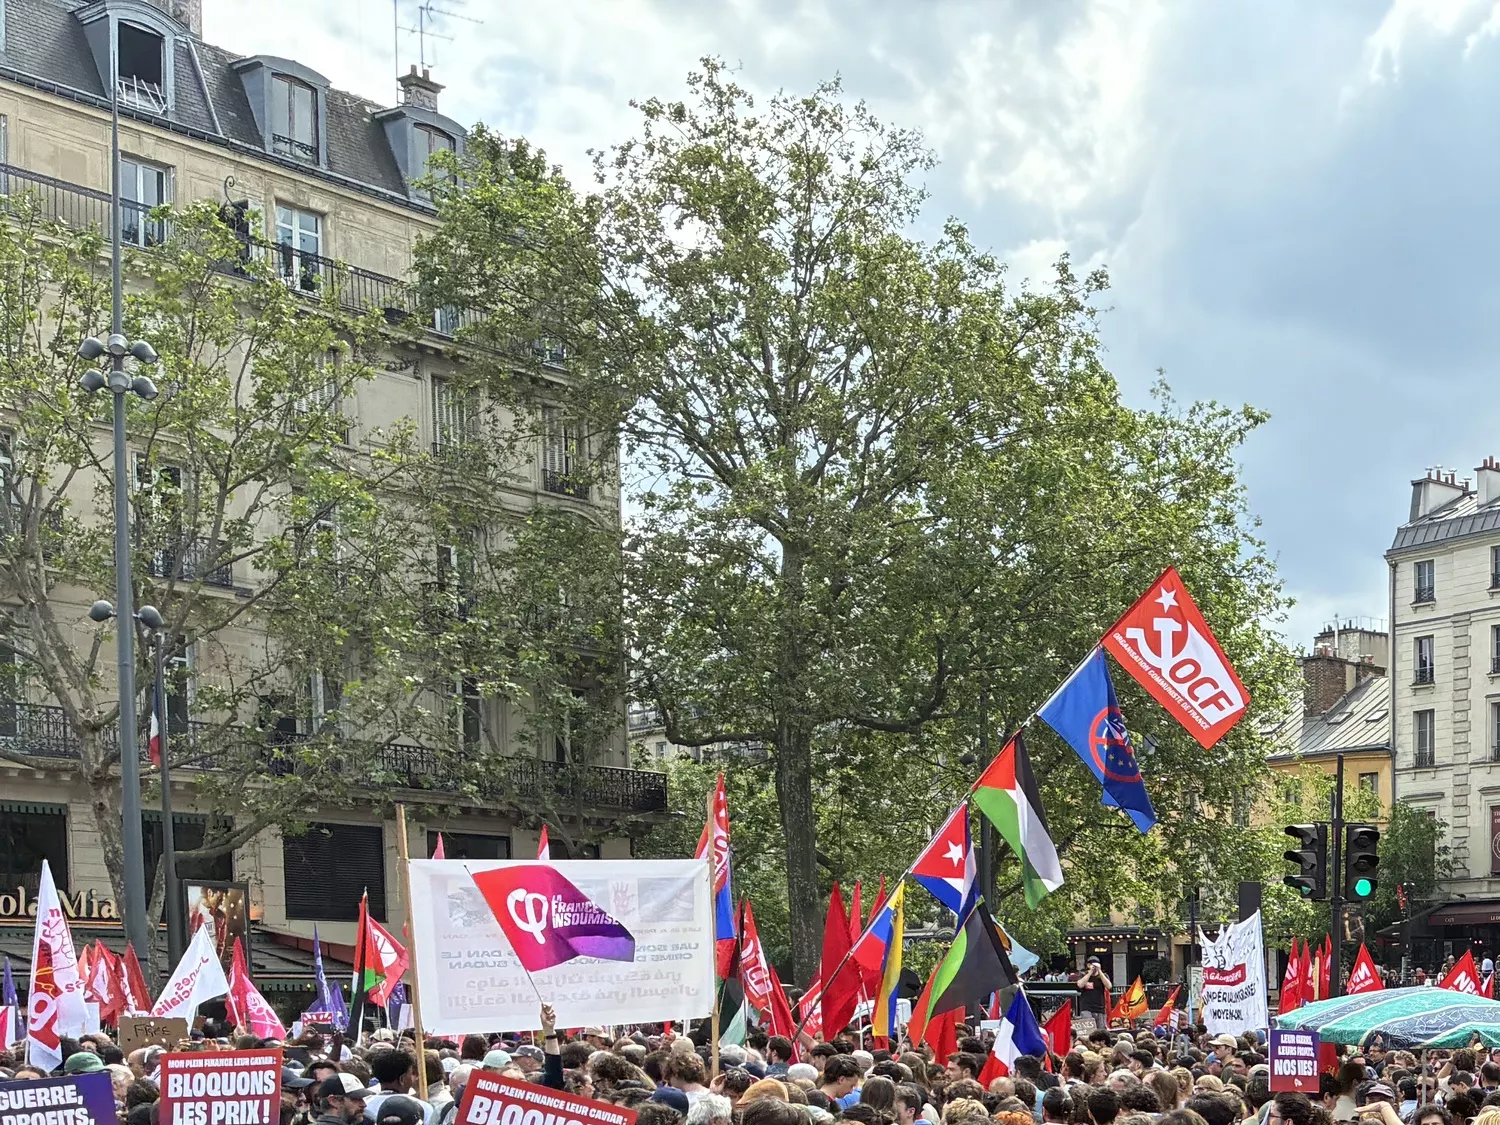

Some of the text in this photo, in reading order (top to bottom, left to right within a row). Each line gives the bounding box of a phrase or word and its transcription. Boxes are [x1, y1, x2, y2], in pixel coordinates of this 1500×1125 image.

[1112, 632, 1211, 731] ORGANISATION COMMUNISTE DE FRANCE
[1168, 658, 1235, 712] OCF
[168, 1060, 185, 1069] MON
[1273, 1058, 1296, 1076] NOS
[167, 1069, 276, 1098] BLOQUONS
[476, 1079, 499, 1094] MON
[498, 1084, 526, 1100] PLEIN
[525, 1091, 566, 1110] FINANCE
[565, 1102, 589, 1117] LEUR
[211, 1099, 260, 1125] PRIX
[262, 1099, 271, 1124] !
